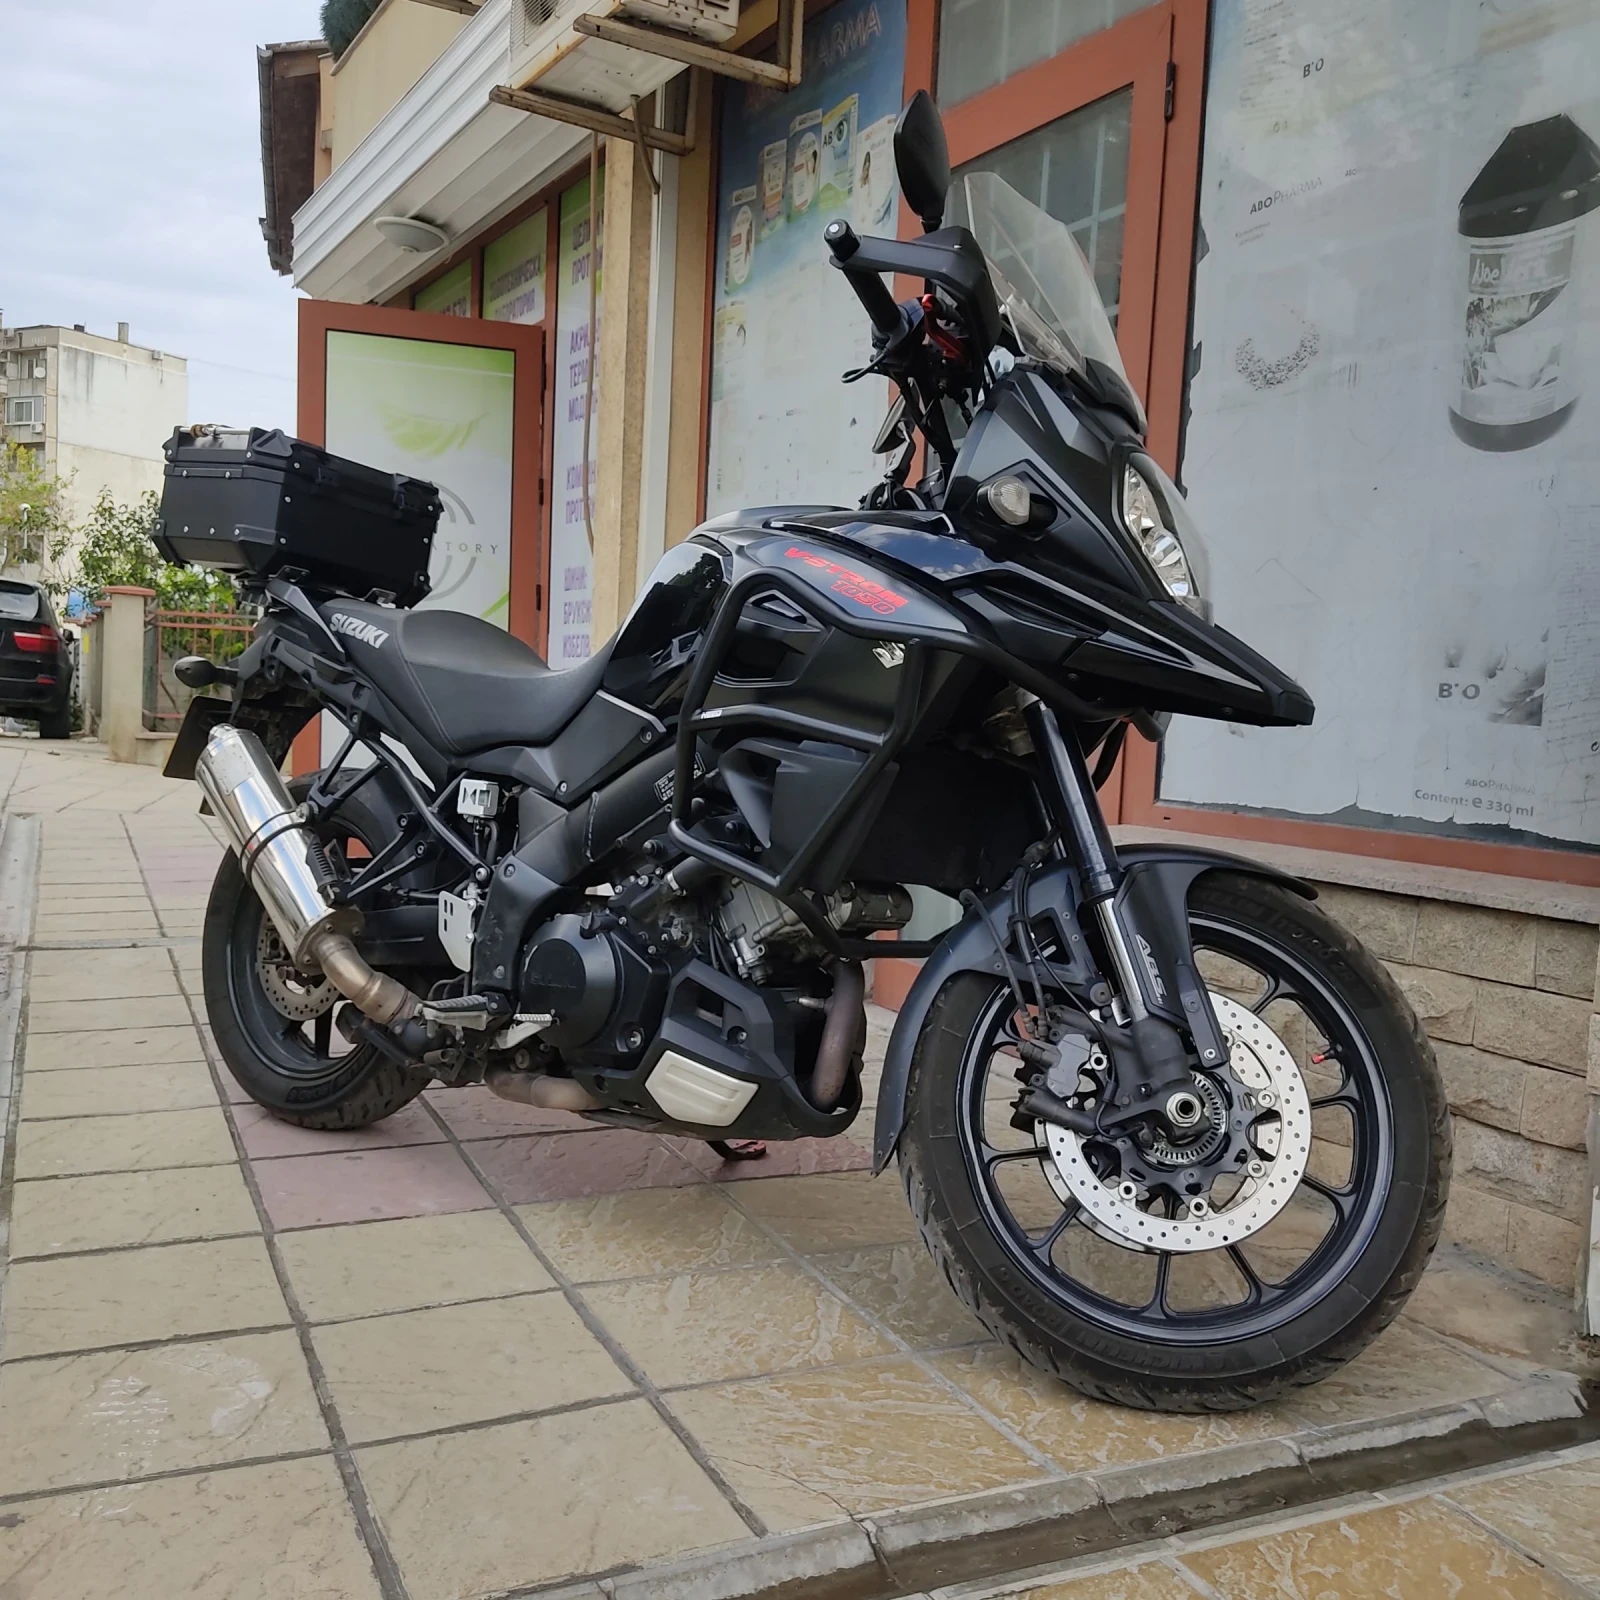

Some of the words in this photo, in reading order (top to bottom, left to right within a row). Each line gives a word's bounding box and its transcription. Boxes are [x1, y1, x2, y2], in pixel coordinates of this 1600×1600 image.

[330, 613, 389, 649] SUZUKI
[1415, 789, 1469, 807] Content:
[1486, 800, 1512, 814] 330
[1516, 806, 1534, 817] ml
[1135, 934, 1167, 998] ABS
